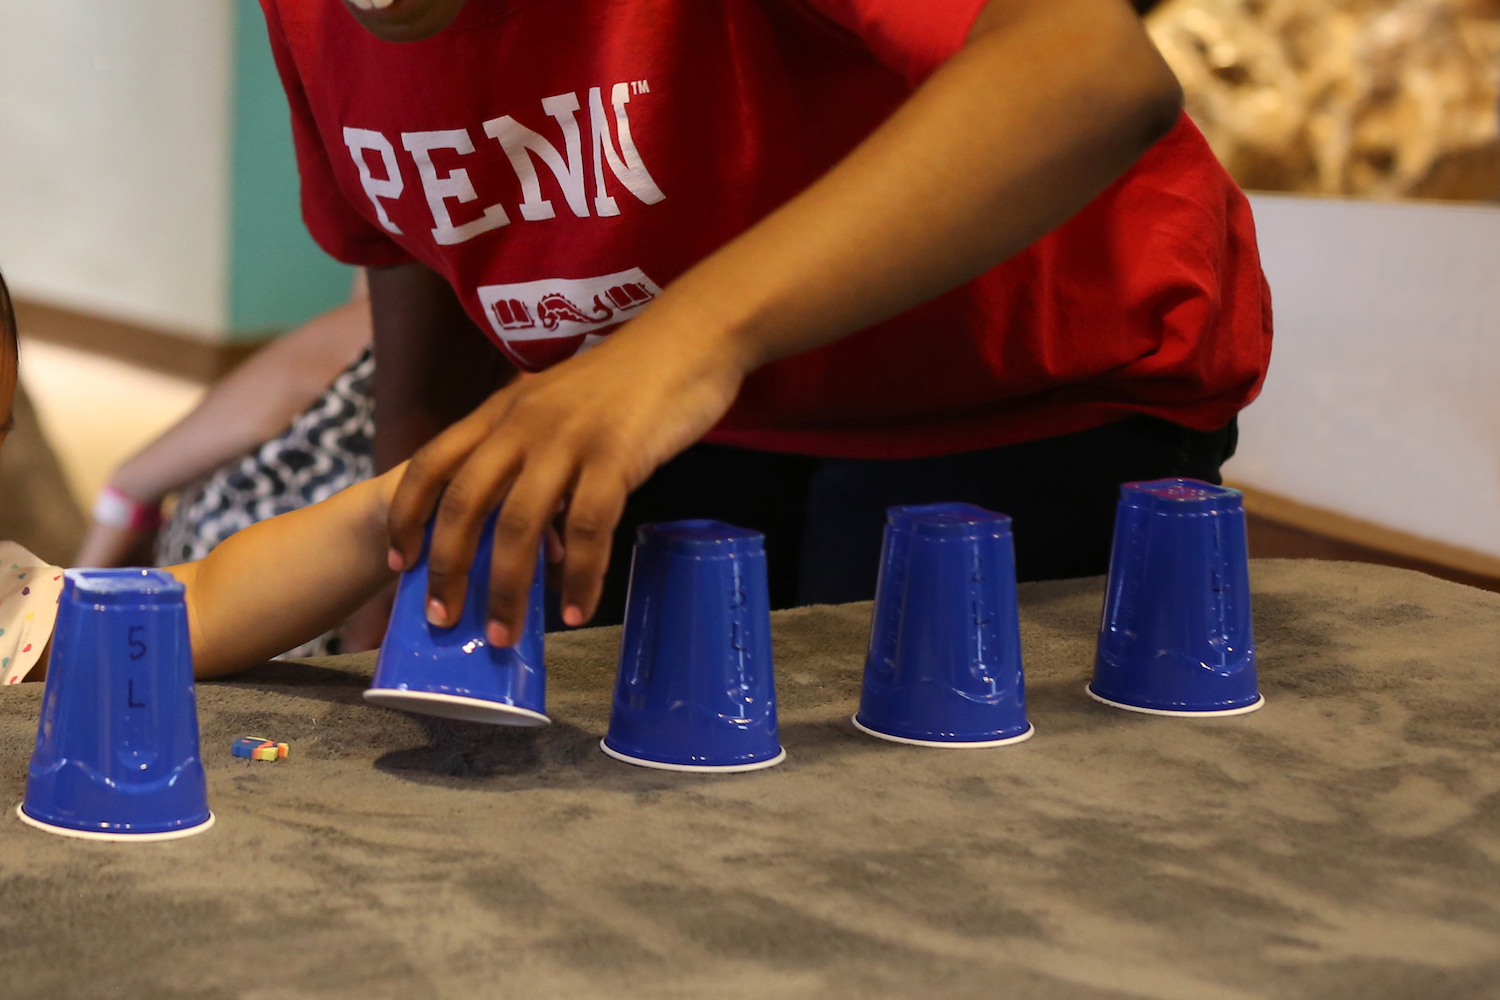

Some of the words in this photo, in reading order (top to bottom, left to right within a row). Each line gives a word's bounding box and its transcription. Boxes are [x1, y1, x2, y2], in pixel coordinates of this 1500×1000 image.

[342, 82, 667, 246] PENN
[128, 626, 147, 660] 5
[128, 679, 146, 708] L
